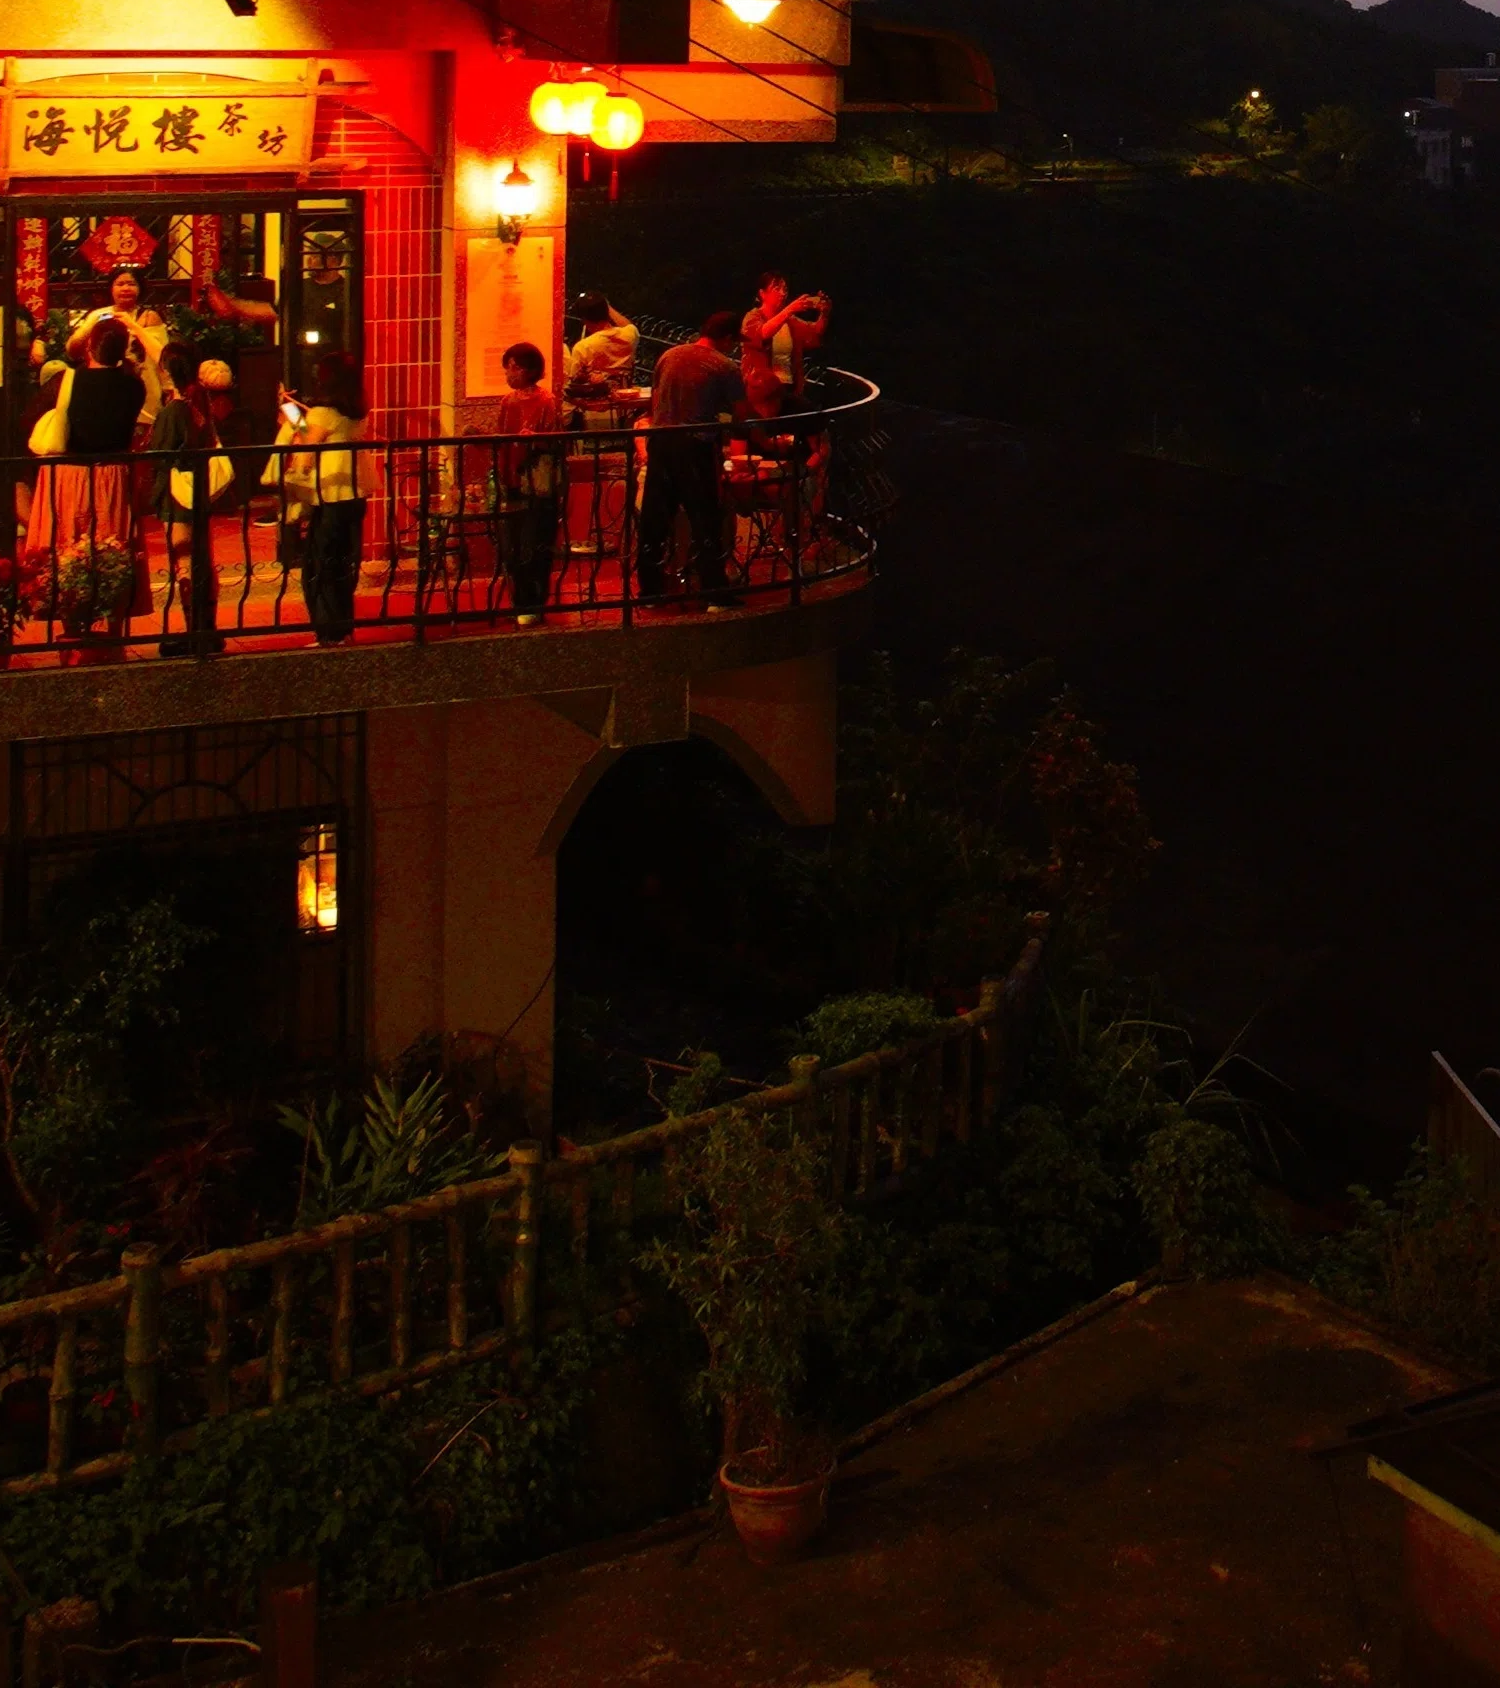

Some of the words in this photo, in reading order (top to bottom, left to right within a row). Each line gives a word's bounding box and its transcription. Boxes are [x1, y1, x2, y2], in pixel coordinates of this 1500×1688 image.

[22, 102, 289, 157] 海悅樓茶坊
[103, 222, 139, 255] 福
